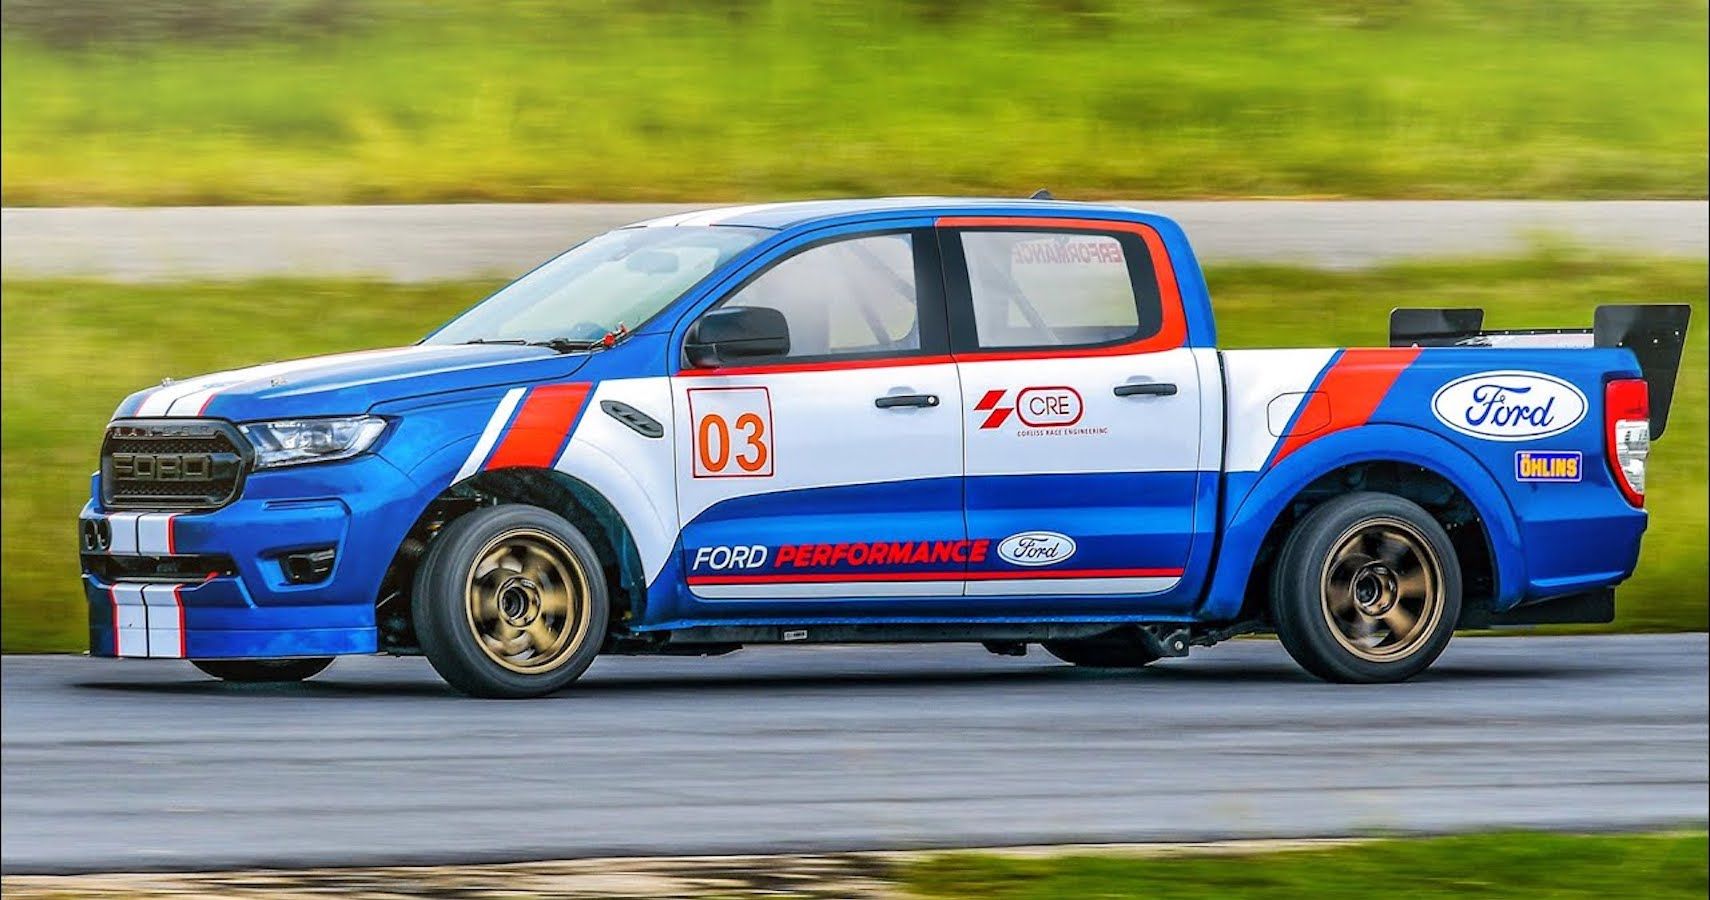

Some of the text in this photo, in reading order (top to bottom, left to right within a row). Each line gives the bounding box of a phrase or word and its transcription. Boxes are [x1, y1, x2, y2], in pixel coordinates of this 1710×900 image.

[1029, 396, 1070, 416] CRE
[1464, 384, 1554, 427] Ford
[699, 412, 768, 473] 03
[111, 452, 211, 481] FORD
[692, 540, 989, 571] FORD PERFORMANCE
[1013, 537, 1059, 558] Ford
